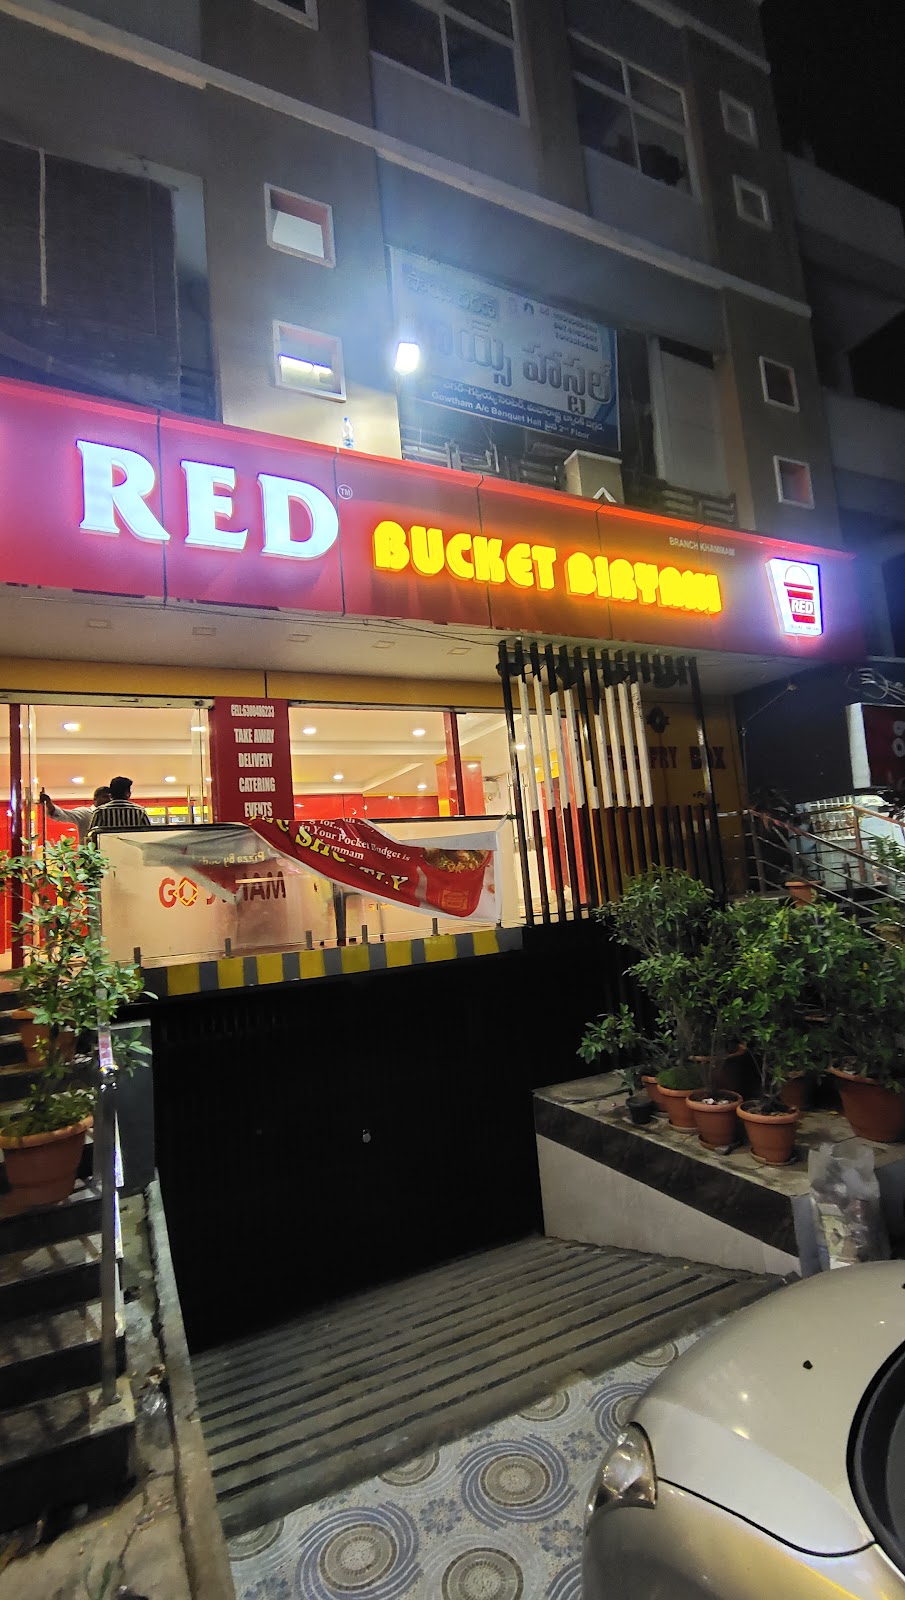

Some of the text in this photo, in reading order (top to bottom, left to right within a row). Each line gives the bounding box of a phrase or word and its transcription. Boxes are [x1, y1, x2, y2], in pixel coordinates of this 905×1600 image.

[432, 391, 473, 409] Gowtham
[475, 402, 490, 413] A/c
[491, 406, 525, 422] Banquet
[526, 416, 542, 426] Hall
[76, 439, 339, 559] RED
[668, 536, 699, 550] BRANCH
[373, 520, 557, 591] BUCKET
[791, 599, 815, 615] RED
[233, 728, 275, 744] TAKE AWAY
[238, 752, 273, 768] DELIVERY
[239, 777, 276, 793] CATERING
[244, 801, 273, 817] EVENTS
[312, 824, 337, 840] Your
